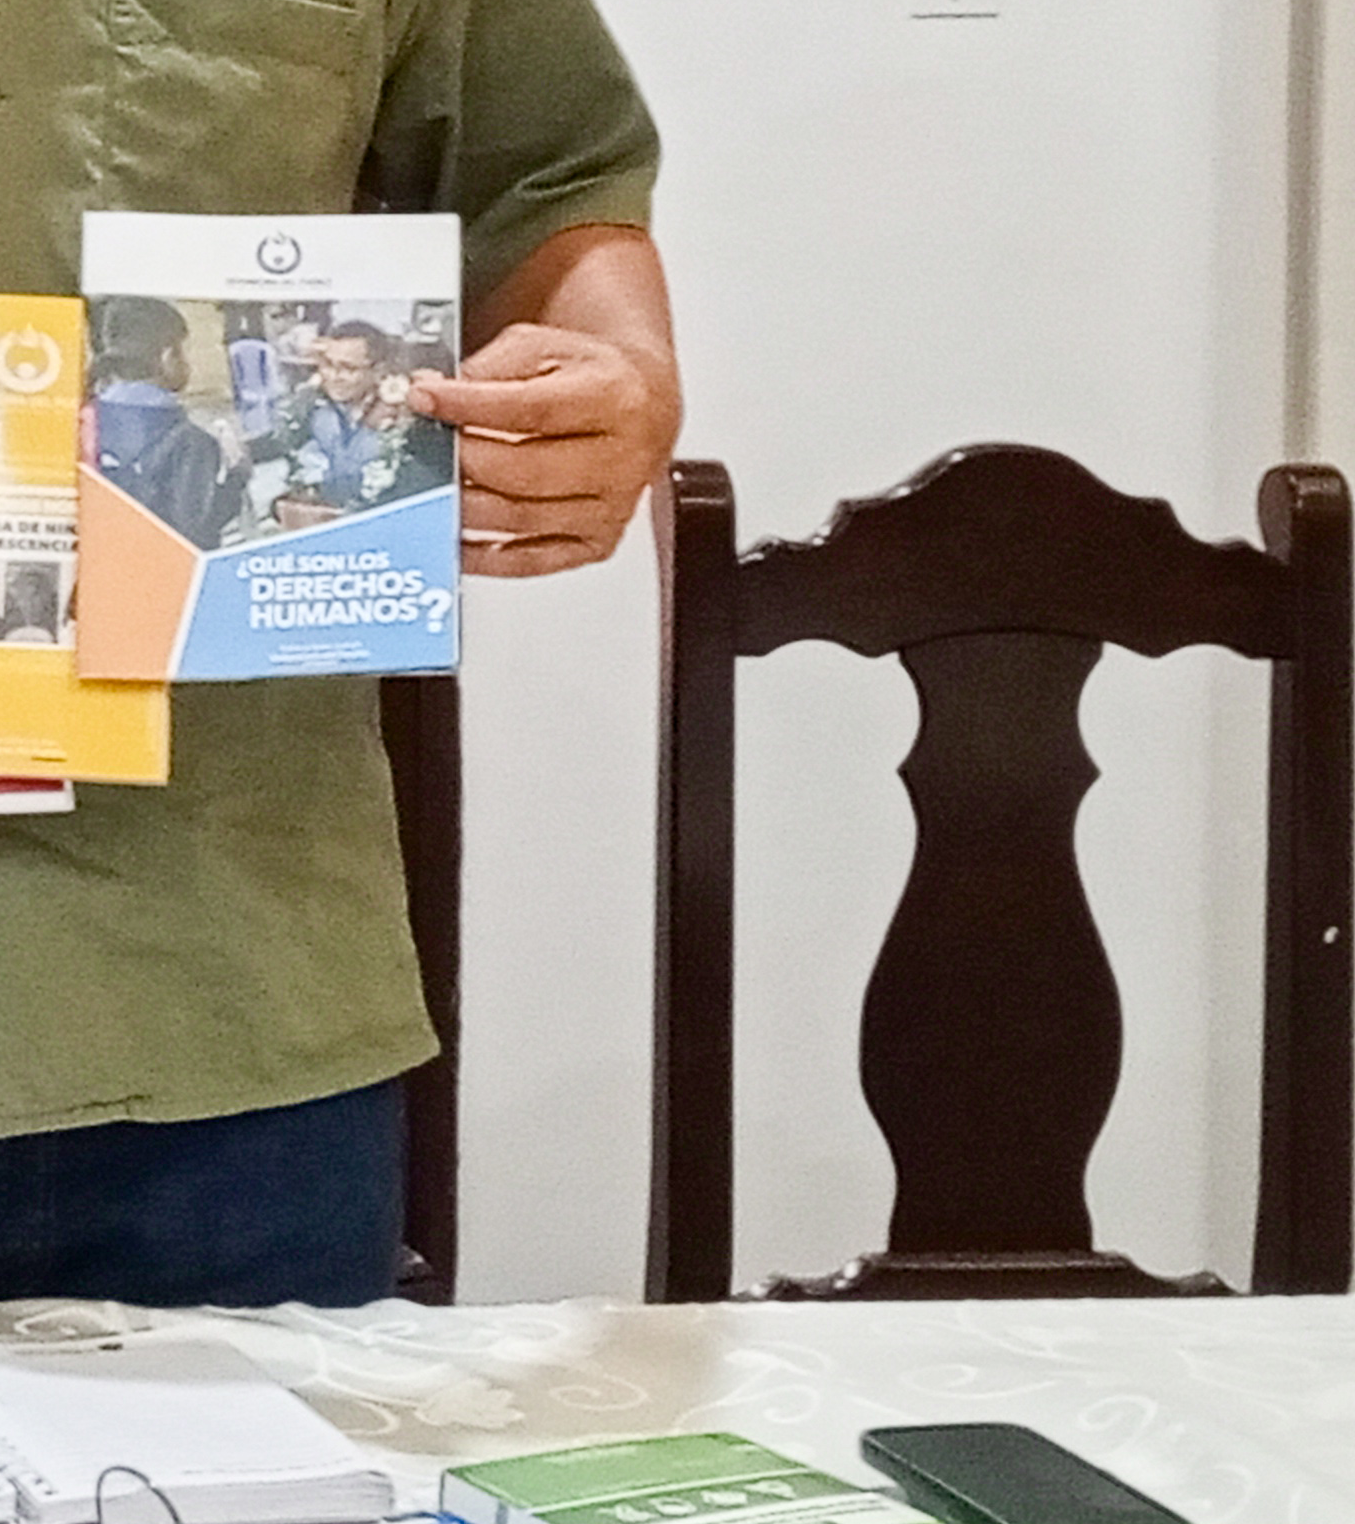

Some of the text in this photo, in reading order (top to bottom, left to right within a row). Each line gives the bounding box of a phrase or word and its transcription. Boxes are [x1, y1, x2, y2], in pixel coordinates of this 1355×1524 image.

[18, 521, 39, 534] DE
[296, 554, 345, 574] SON
[347, 551, 391, 571] LOS
[250, 569, 424, 602] DERECHOS
